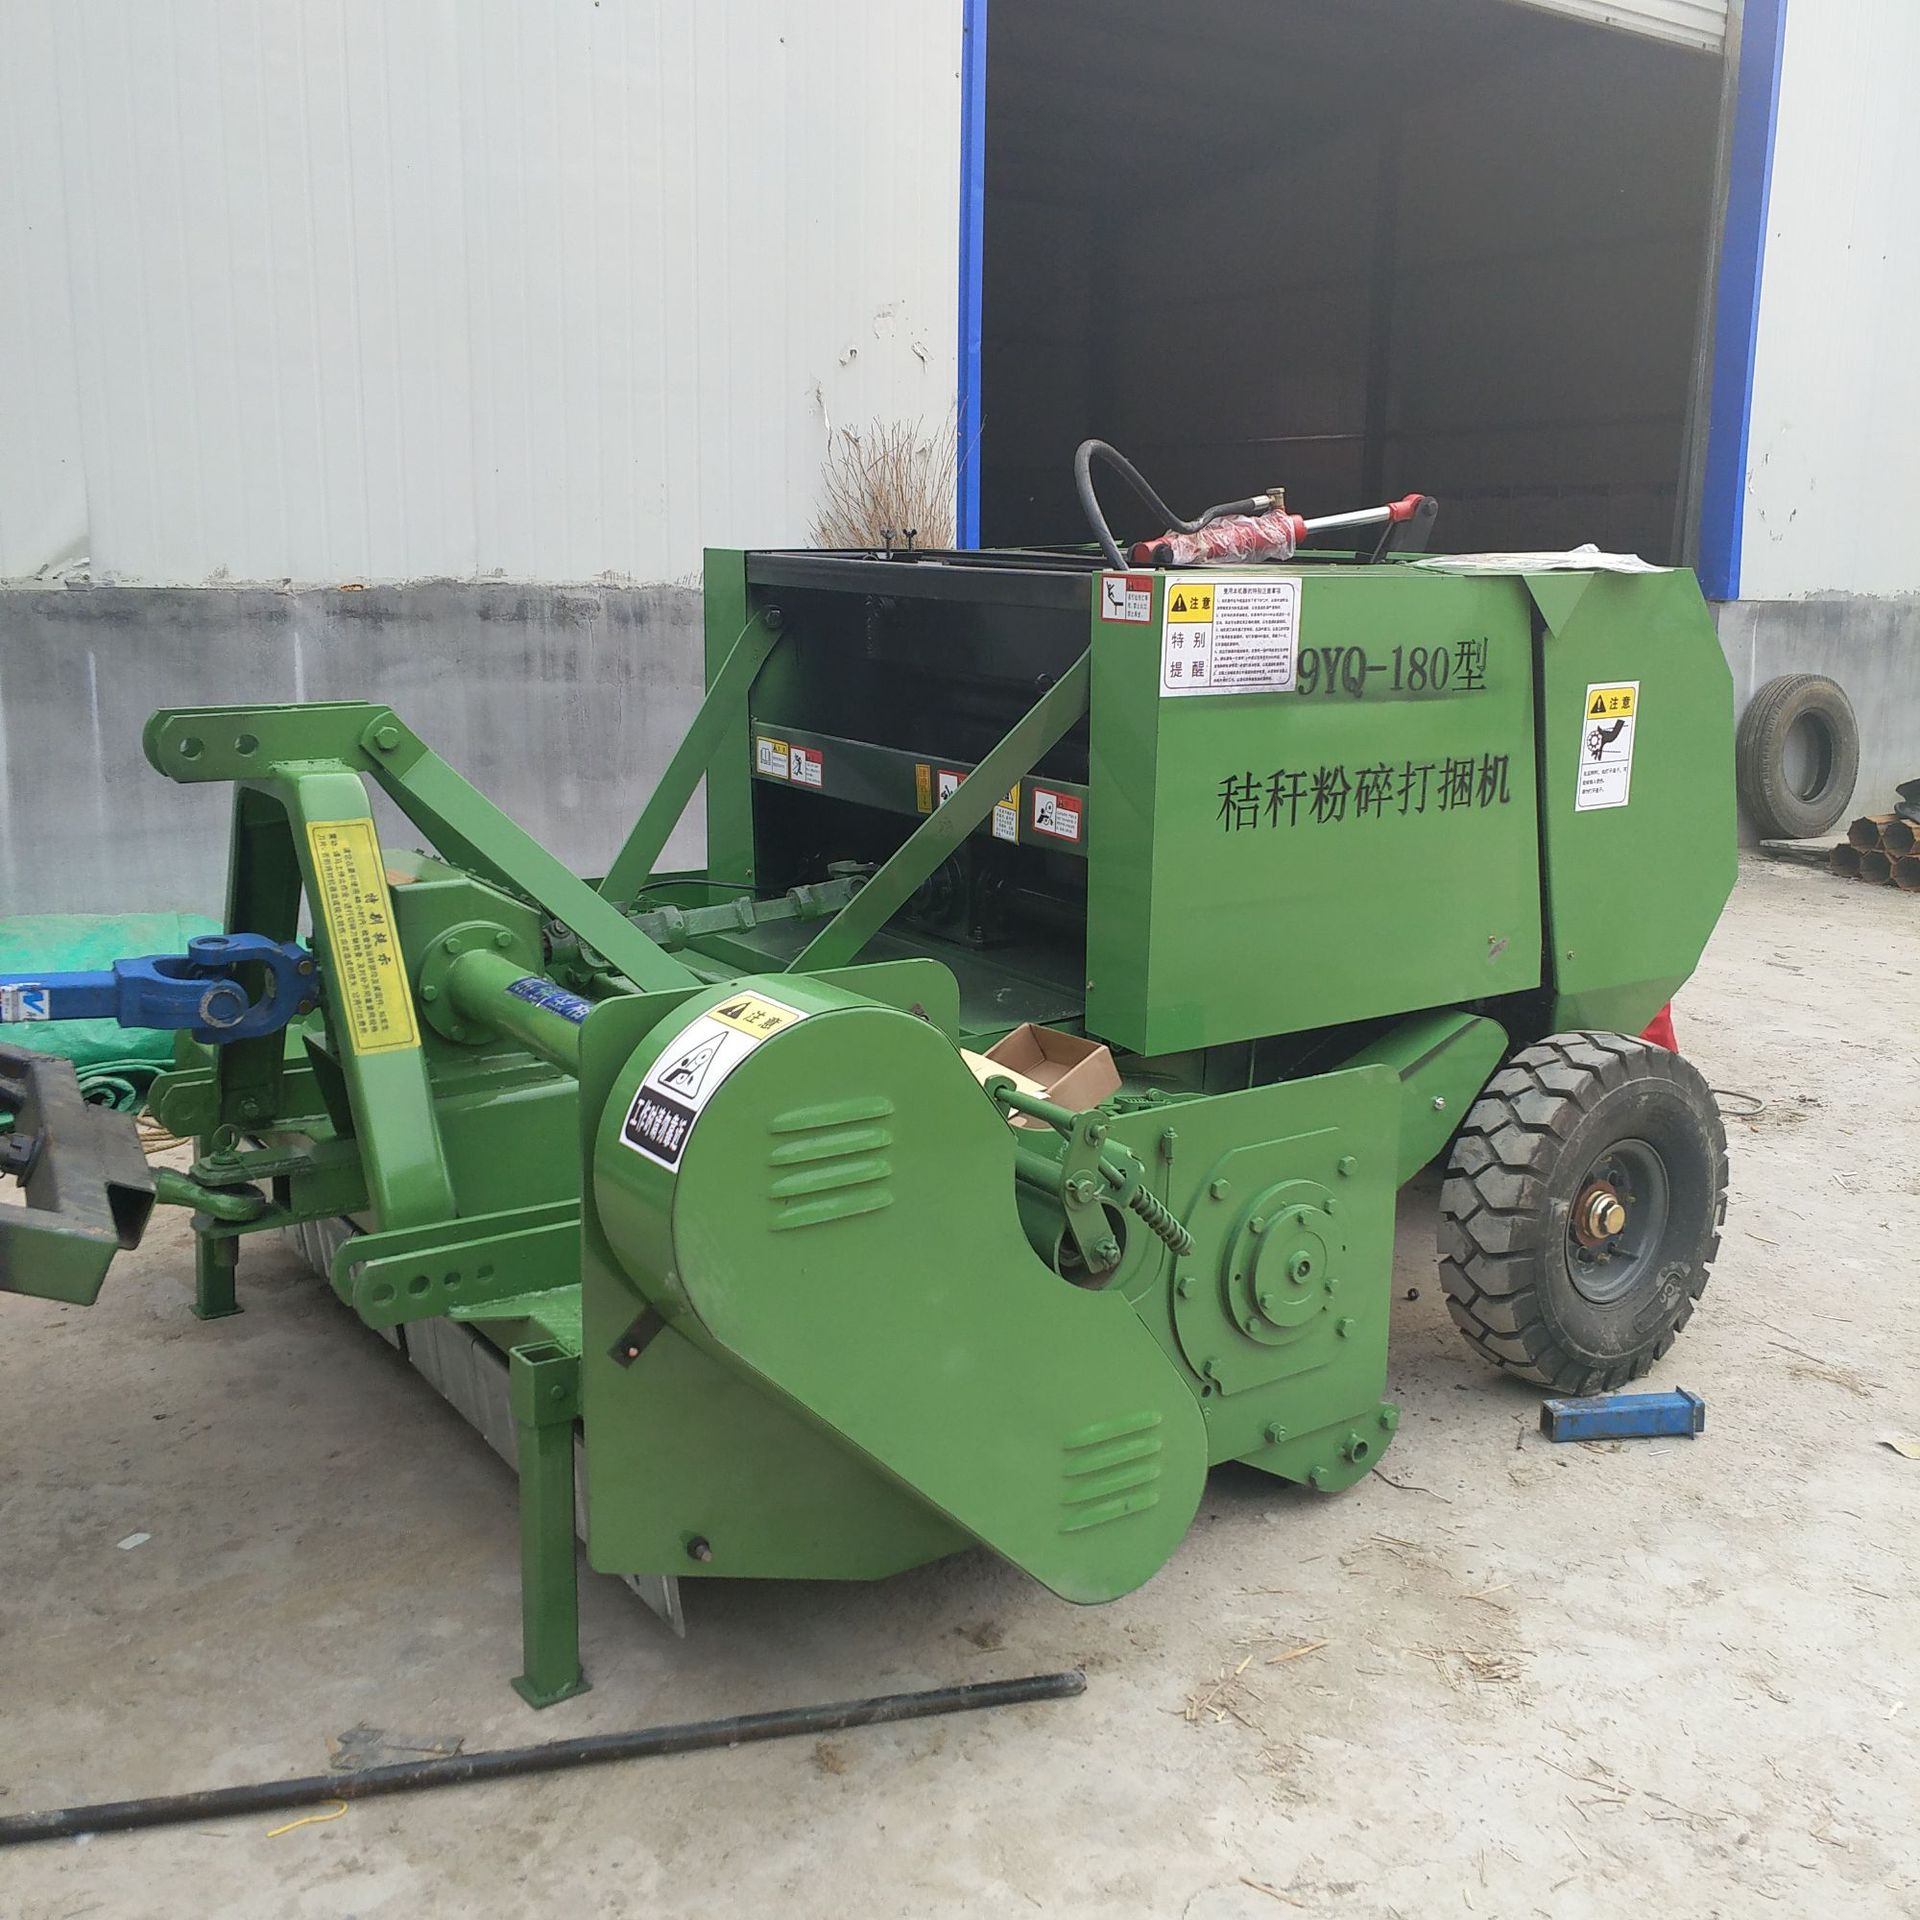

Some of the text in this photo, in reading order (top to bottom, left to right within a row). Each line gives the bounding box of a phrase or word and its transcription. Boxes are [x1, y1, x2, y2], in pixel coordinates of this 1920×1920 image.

[1189, 596, 1211, 610] 注意
[1171, 631, 1206, 649] 特别
[1169, 660, 1205, 678] 提醒
[1297, 636, 1489, 698] 9YQ-180型
[1609, 695, 1631, 710] 注意
[1216, 753, 1510, 832] 秸秆粉碎打捆机
[364, 892, 391, 966] 特别提示
[743, 1009, 783, 1030] 注意
